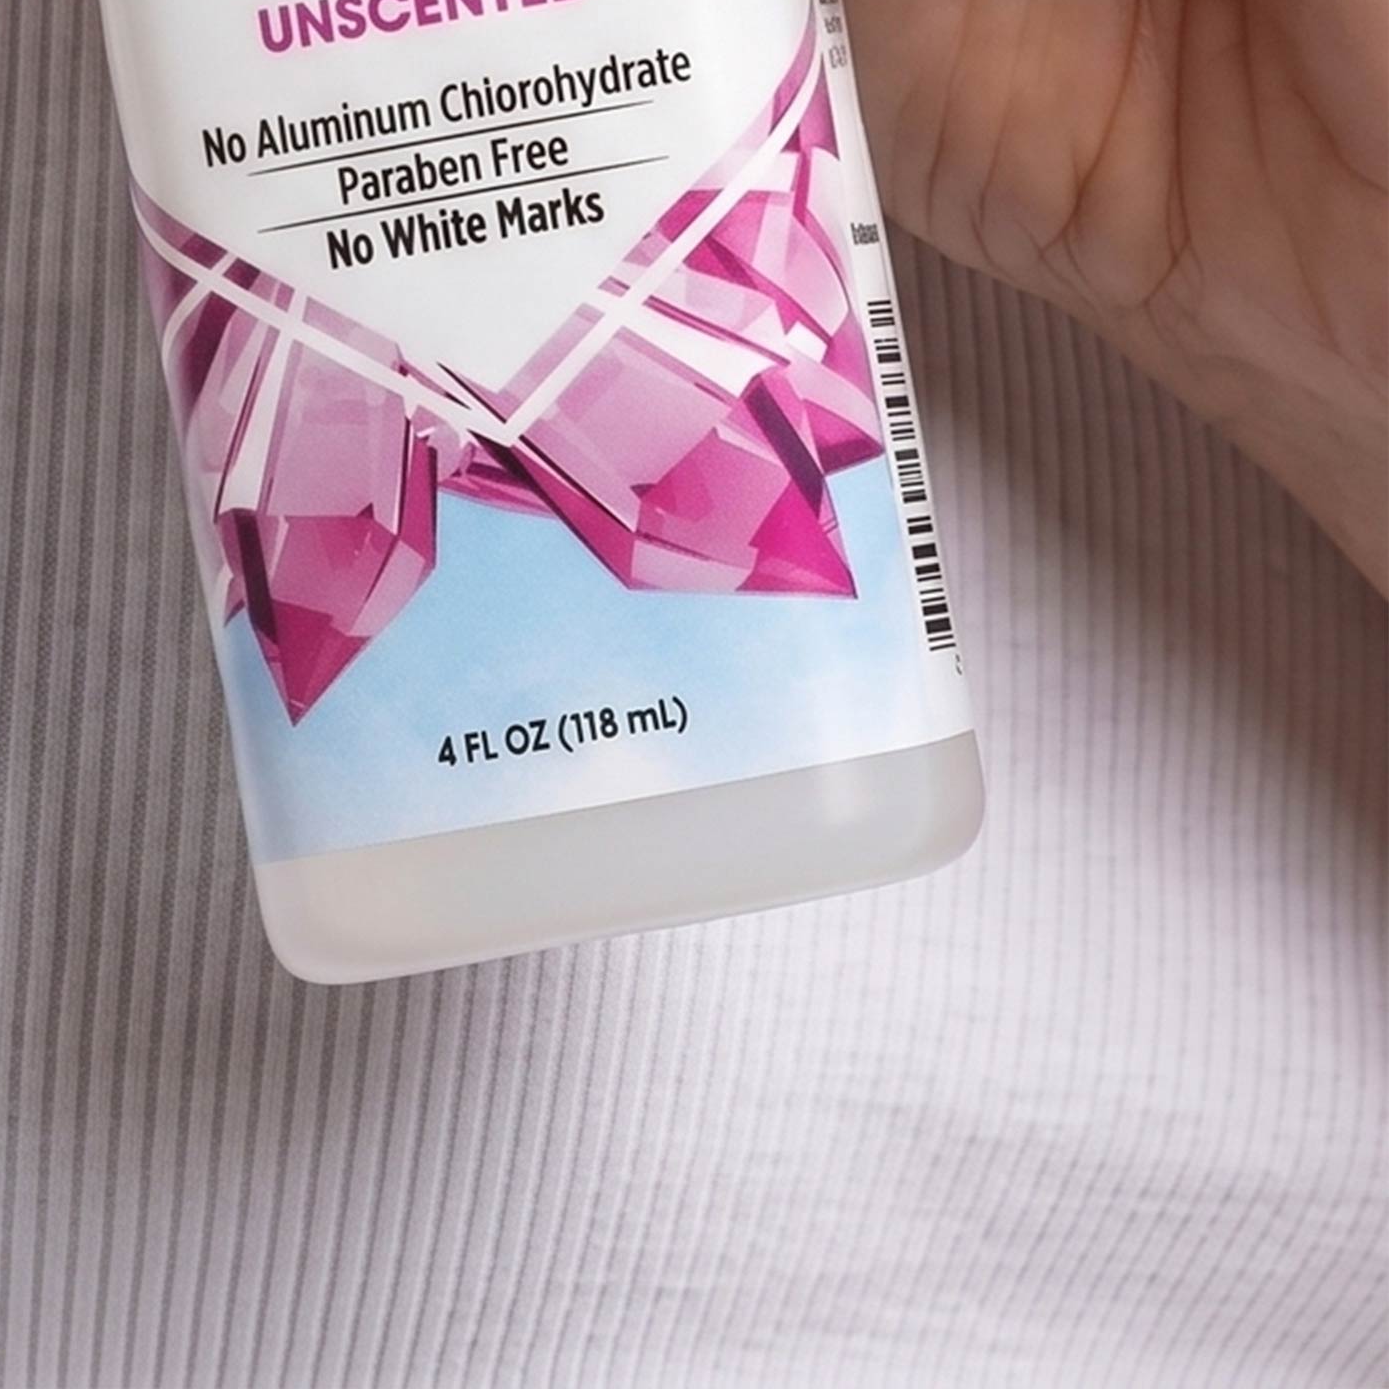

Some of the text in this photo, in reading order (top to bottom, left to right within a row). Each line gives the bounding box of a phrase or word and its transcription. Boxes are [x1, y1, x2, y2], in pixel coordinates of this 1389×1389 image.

[203, 128, 246, 167] No
[258, 100, 430, 158] Aluminum
[338, 137, 568, 204] Paraben Free
[327, 188, 604, 269] No White Marks
[439, 697, 687, 765] 4 FL OZ (118 mL)
